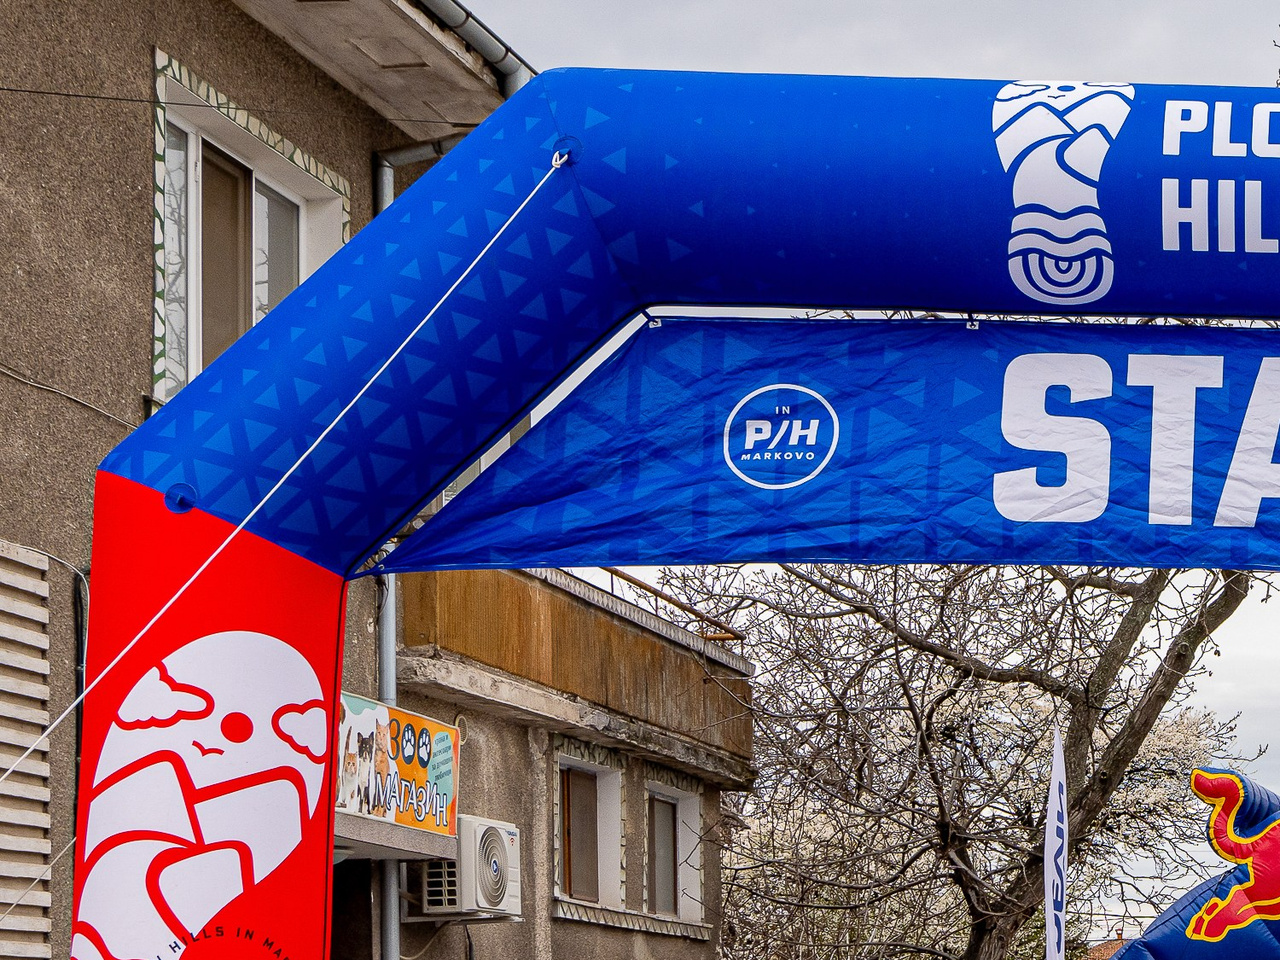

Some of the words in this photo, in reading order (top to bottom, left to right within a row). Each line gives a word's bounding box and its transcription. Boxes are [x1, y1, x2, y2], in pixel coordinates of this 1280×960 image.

[775, 405, 790, 415] IN
[744, 419, 820, 450] P/H
[740, 451, 815, 461] MARKOVO
[375, 770, 448, 827] МАГАЗИН
[168, 926, 224, 953] HILLS
[236, 927, 254, 940] IN
